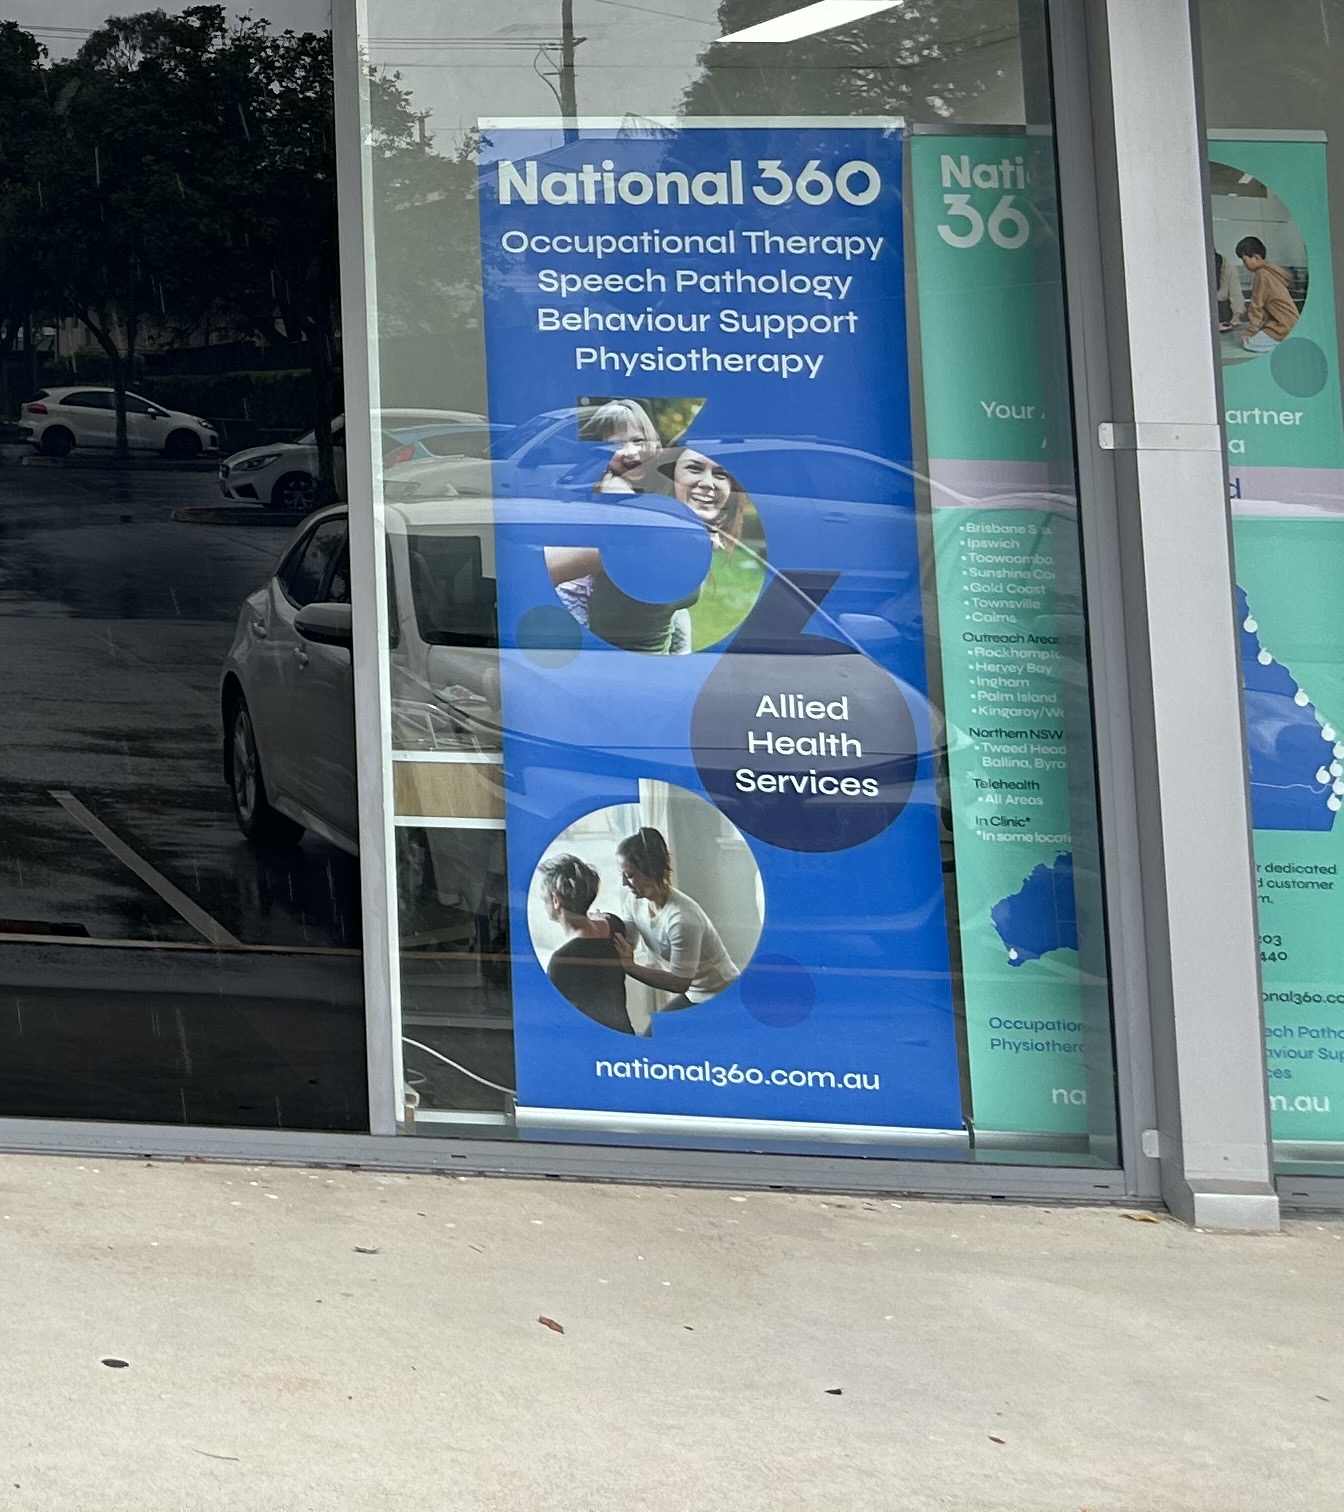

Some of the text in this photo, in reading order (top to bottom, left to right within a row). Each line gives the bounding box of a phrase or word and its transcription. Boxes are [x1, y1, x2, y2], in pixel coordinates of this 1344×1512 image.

[940, 154, 1030, 189] Nati
[501, 229, 884, 261] Occupational Therapy
[538, 268, 853, 300] Speech Pathology
[538, 306, 859, 339] Behaviour Support
[575, 346, 824, 379] Physiotherapy
[980, 400, 1035, 420] Your
[966, 523, 1025, 535] Brisbane
[967, 538, 1020, 549] Ipswich
[969, 567, 1031, 579] Sunshine
[970, 582, 1046, 594] Gold Coast
[972, 597, 1041, 609] Townsville
[972, 611, 1017, 623] Cairns
[962, 632, 1025, 644] Outreach
[975, 662, 1053, 676] Hervey Bay
[976, 676, 1030, 688] Ingham
[977, 691, 1057, 703] Palm Island
[755, 694, 850, 721] Allied
[969, 727, 1064, 739] Northern NSW
[748, 730, 863, 758] Health
[981, 742, 1027, 754] Tweed
[735, 769, 879, 797] Services
[973, 778, 1040, 791] Telehealth
[984, 794, 1044, 805] All Areas
[975, 816, 988, 827] In
[997, 832, 1033, 842] some
[1264, 862, 1337, 876] dedicated
[1266, 878, 1334, 890] customer
[595, 1057, 880, 1092] national360.com.au
